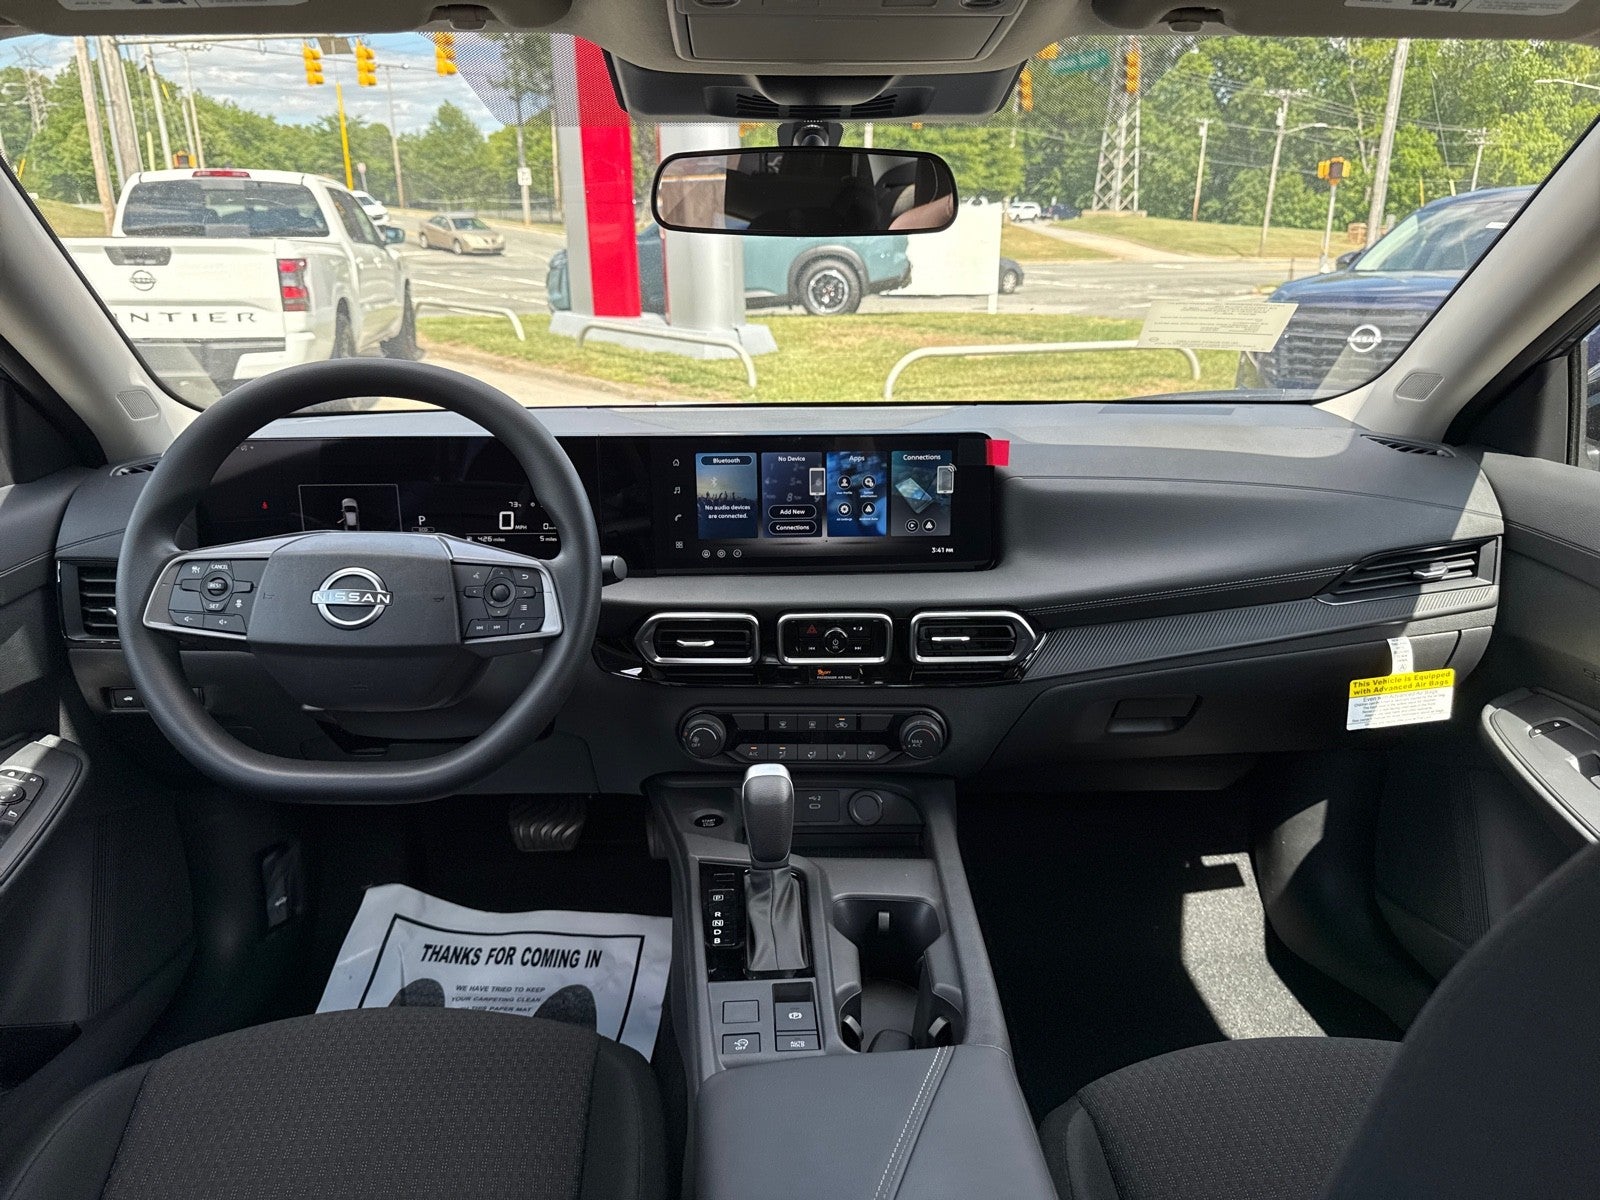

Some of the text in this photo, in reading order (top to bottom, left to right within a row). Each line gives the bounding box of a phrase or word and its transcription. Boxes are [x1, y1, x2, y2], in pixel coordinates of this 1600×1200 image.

[115, 312, 256, 323] NTIER
[848, 455, 865, 463] Apps
[418, 515, 426, 526] P
[499, 511, 515, 530] 0
[315, 592, 390, 604] NISSAN
[1352, 681, 1371, 689] This
[1372, 677, 1402, 687] Vehicle
[1414, 671, 1451, 681] Equipped
[1353, 688, 1372, 696] with
[1373, 683, 1413, 693] Advanced
[1428, 679, 1449, 687] Bags
[419, 943, 603, 969] THANKS FOR COMING IN
[455, 984, 468, 992] WE
[490, 985, 513, 993] TRIED
